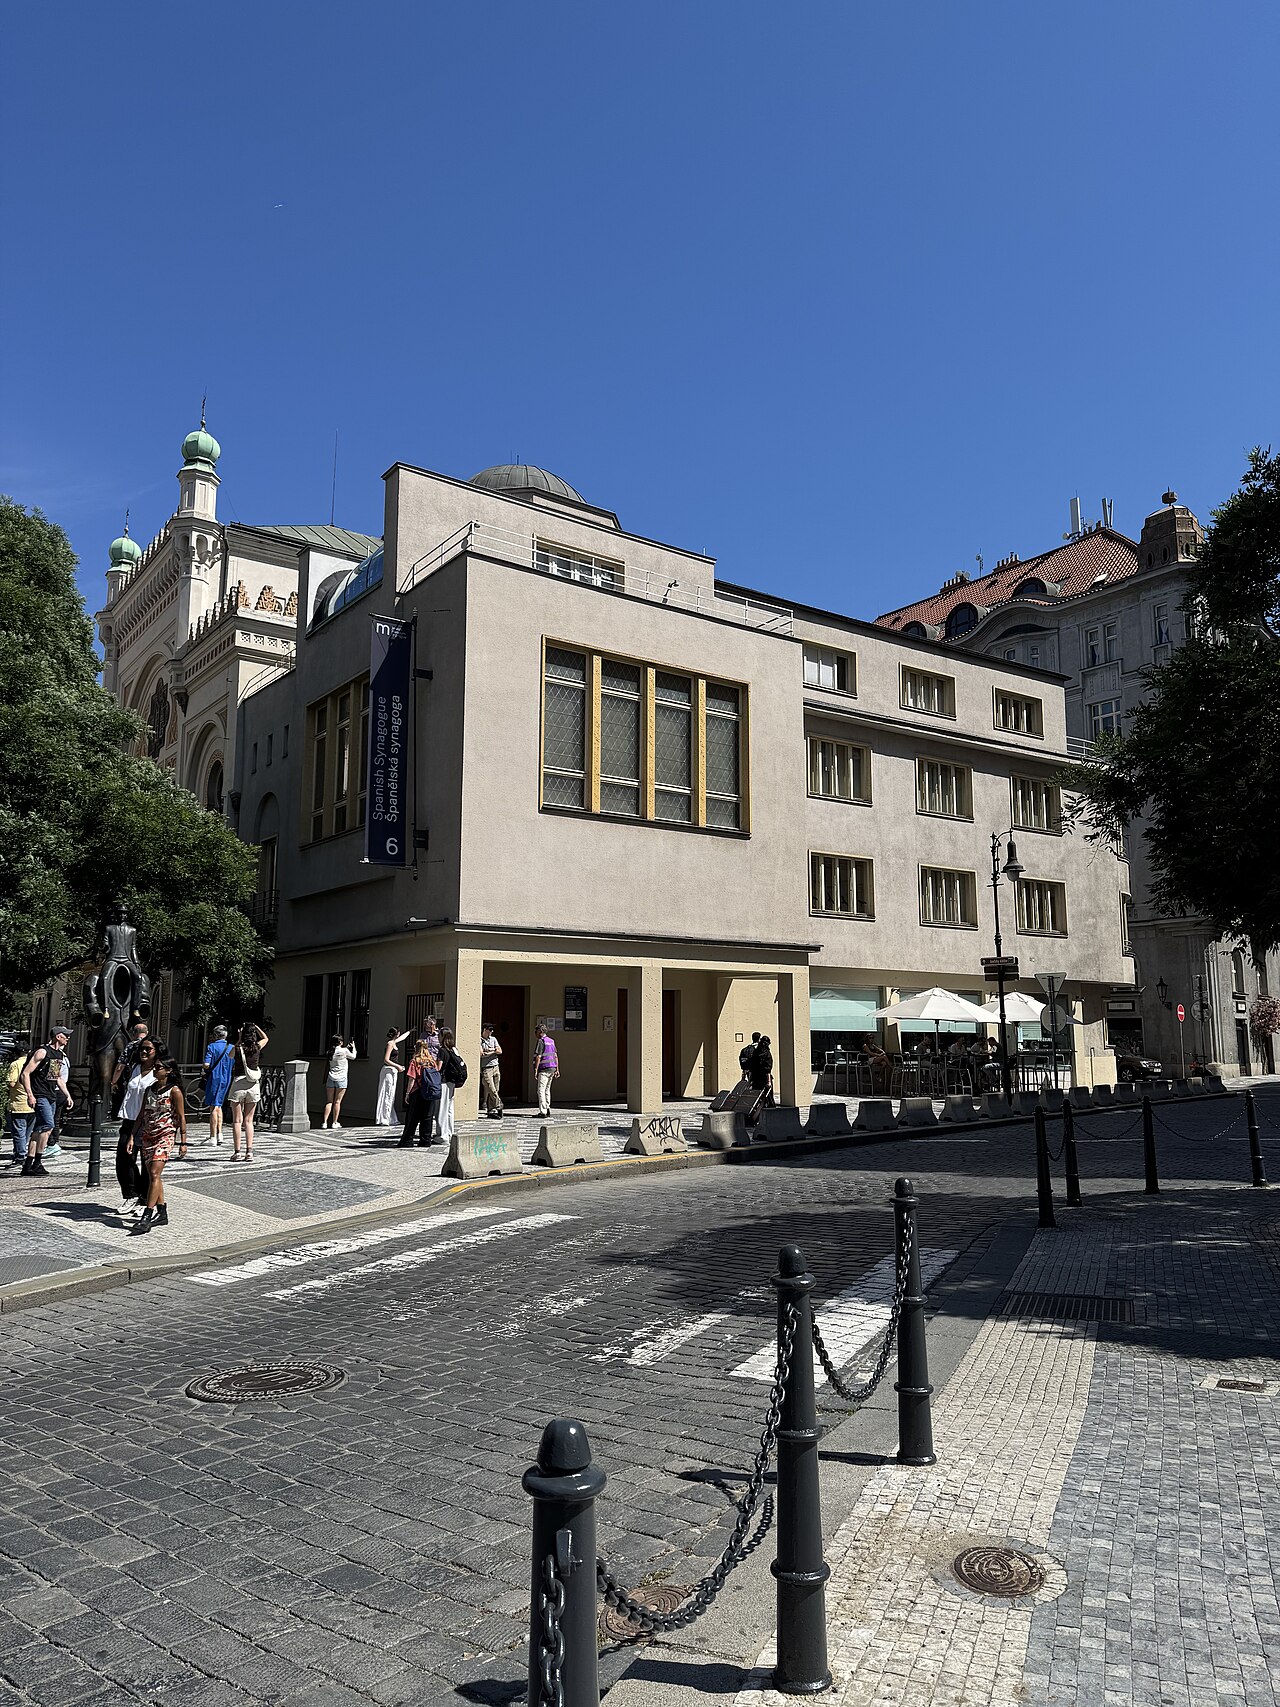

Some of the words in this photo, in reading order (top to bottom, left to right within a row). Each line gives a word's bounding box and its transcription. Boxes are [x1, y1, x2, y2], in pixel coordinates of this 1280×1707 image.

[374, 697, 388, 766] Synagogue
[390, 695, 403, 754] synagoga
[372, 769, 385, 821] Spanish
[384, 757, 400, 823] Španělská
[386, 837, 399, 855] 6
